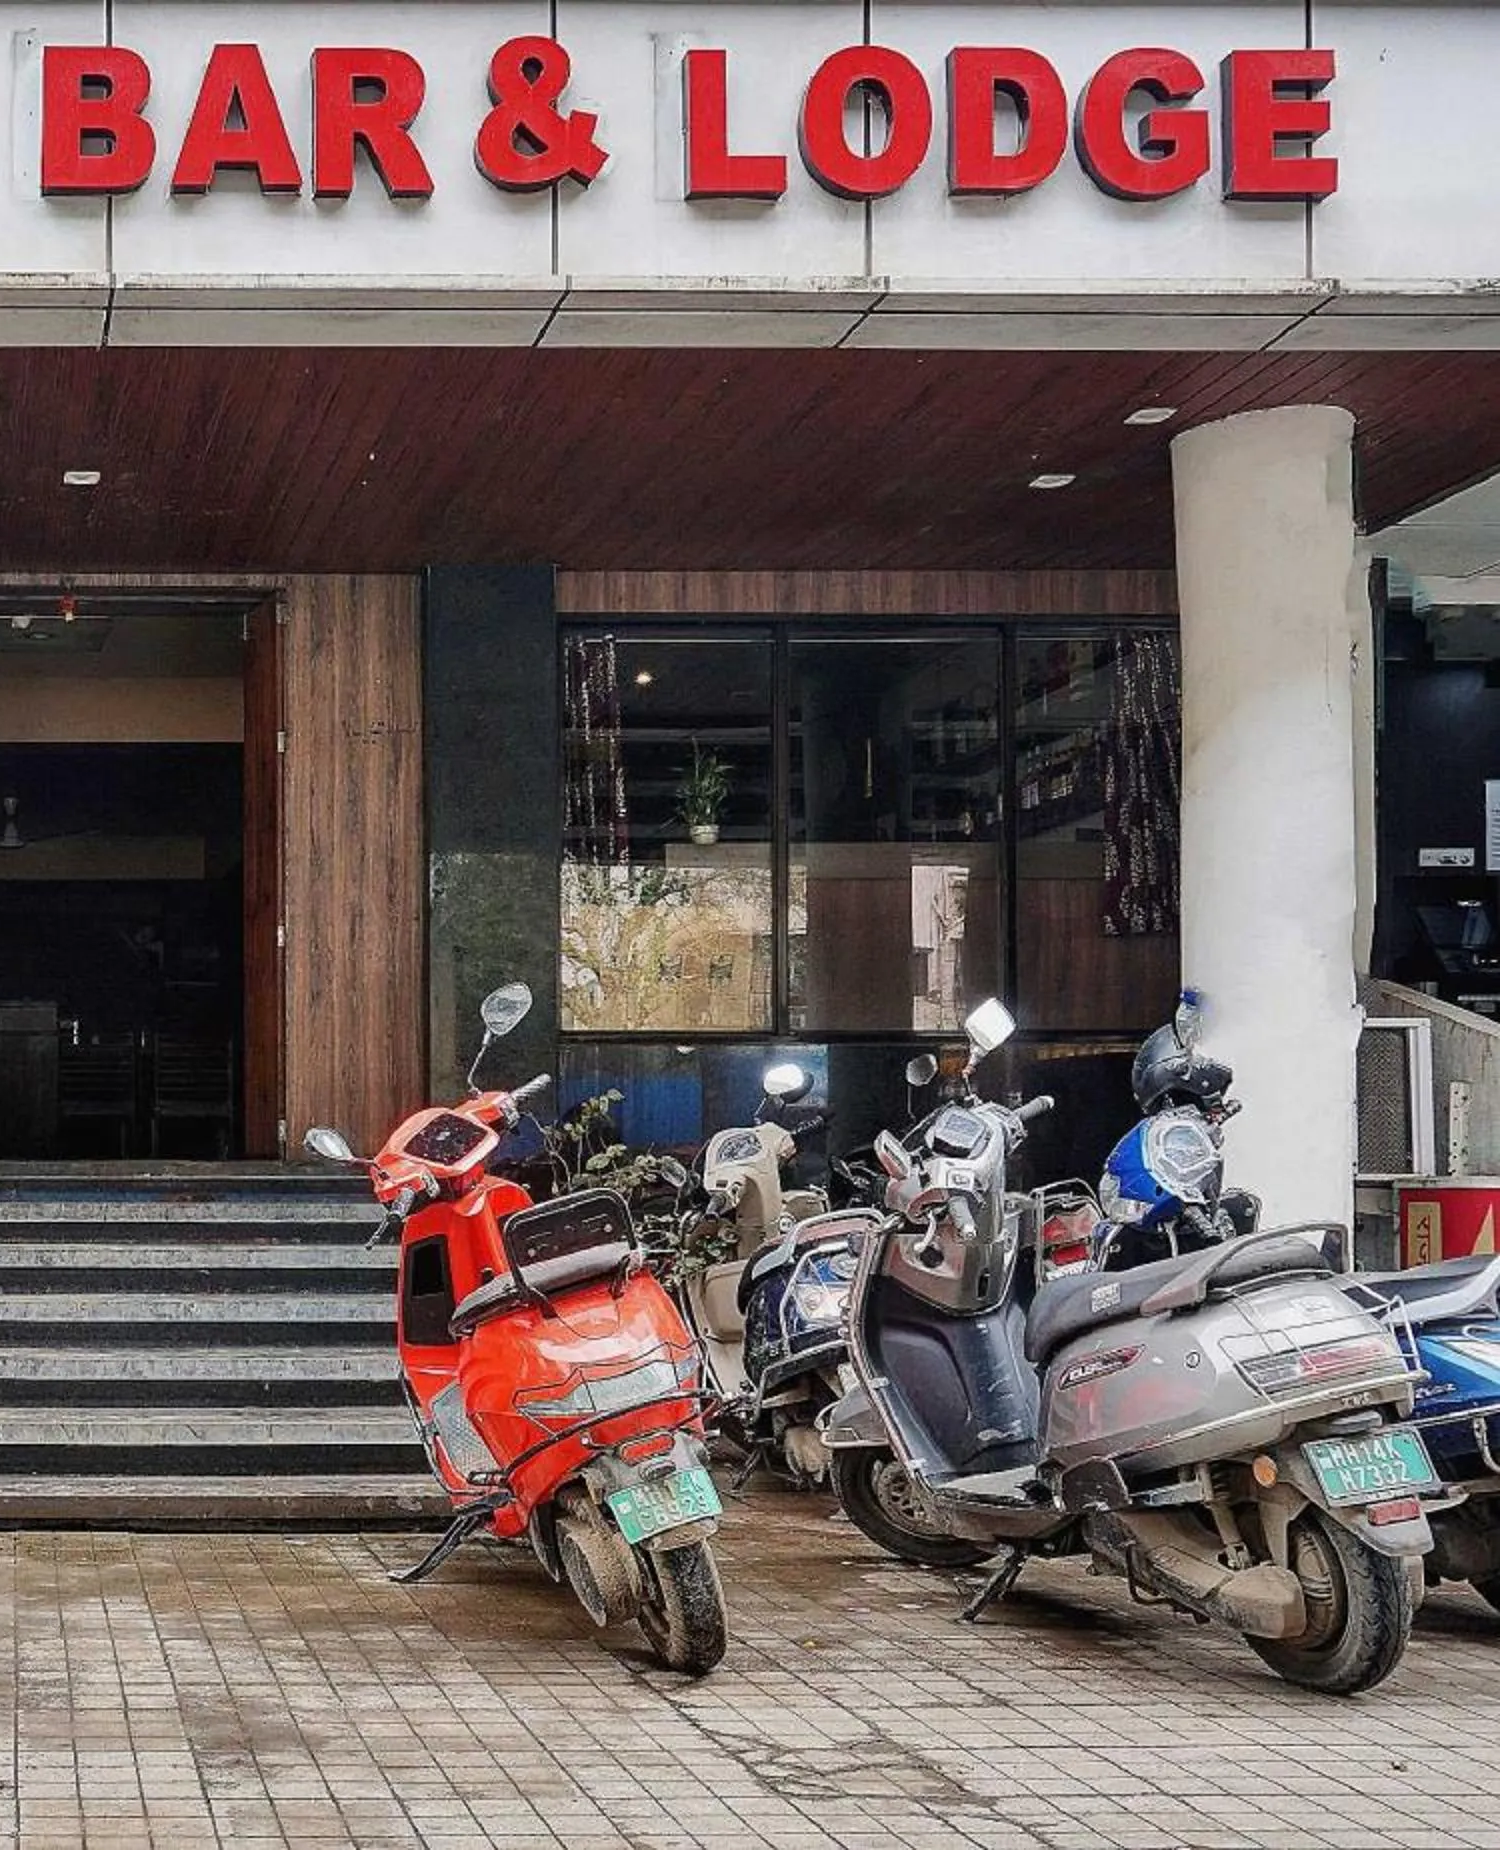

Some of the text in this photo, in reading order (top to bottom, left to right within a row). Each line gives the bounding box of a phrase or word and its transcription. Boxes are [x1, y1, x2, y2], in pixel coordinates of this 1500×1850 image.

[41, 44, 434, 200] BAR
[474, 35, 610, 191] &
[682, 45, 1339, 203] LODGE
